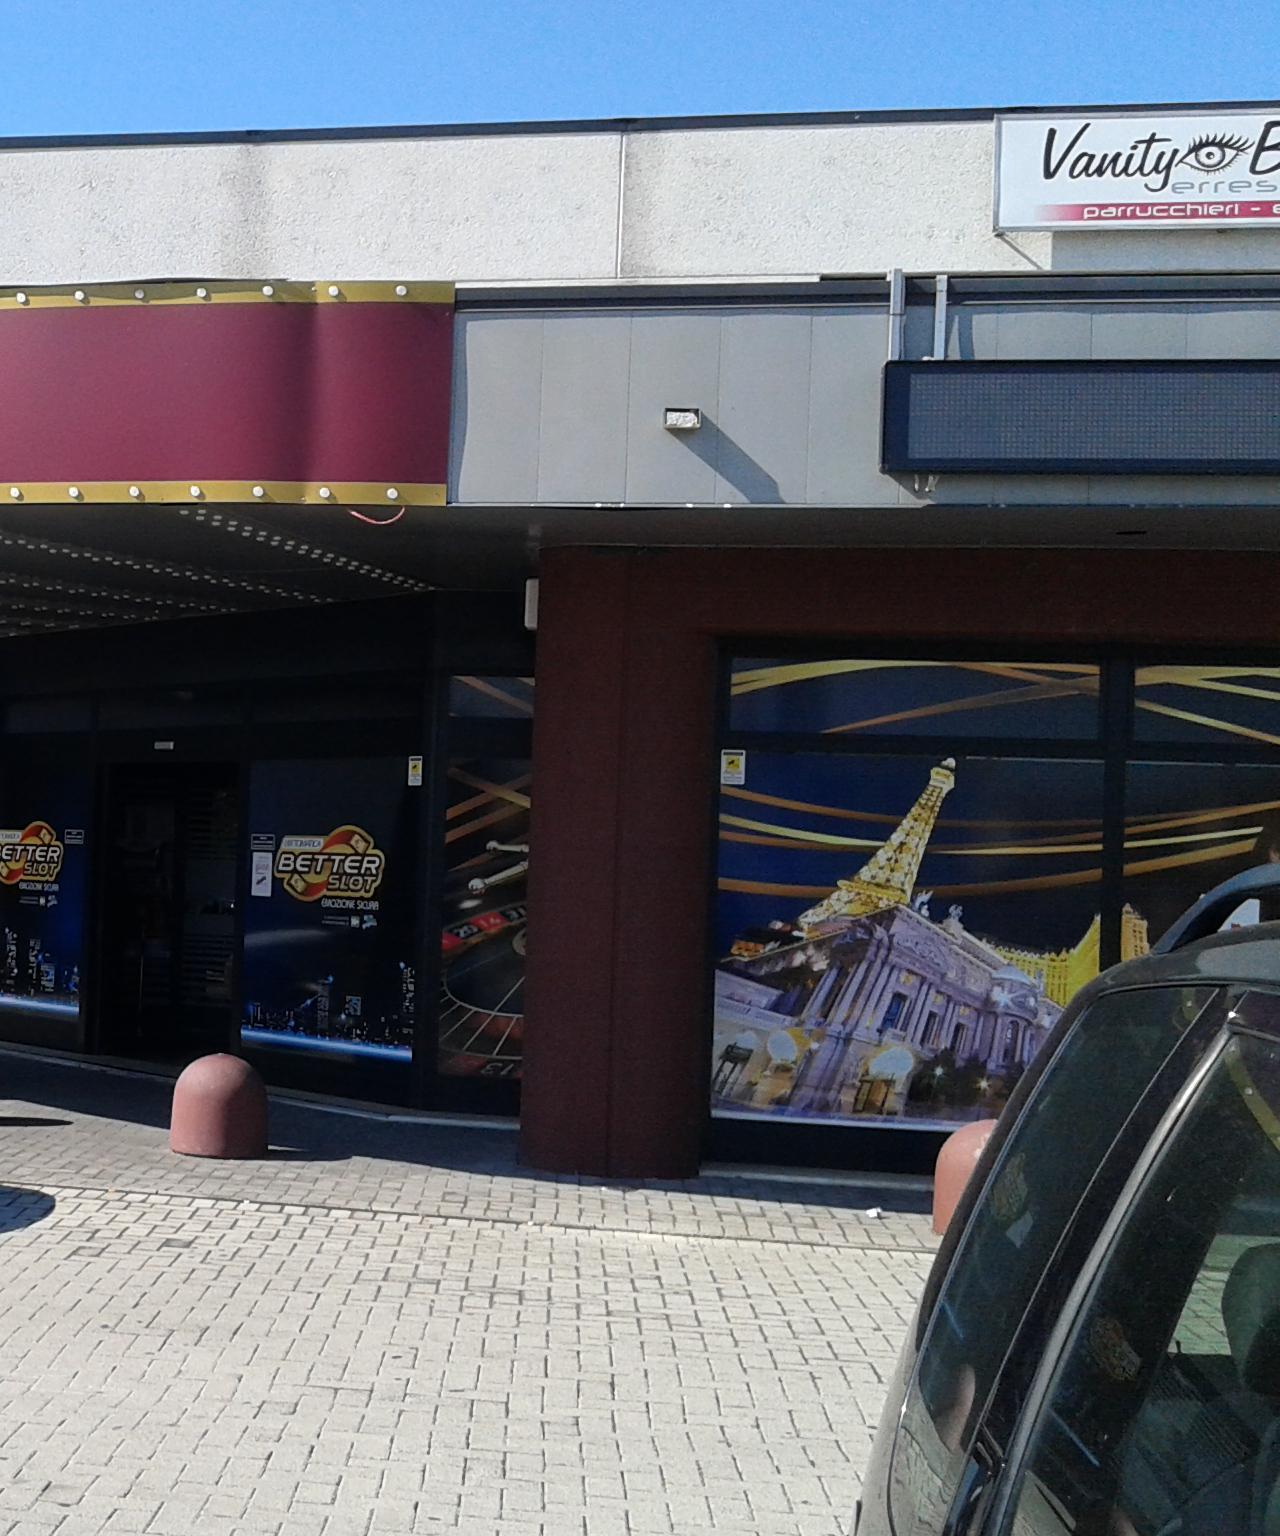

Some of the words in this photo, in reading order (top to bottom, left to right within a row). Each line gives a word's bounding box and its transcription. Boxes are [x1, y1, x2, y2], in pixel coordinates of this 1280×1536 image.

[1042, 122, 1181, 193] Vanity
[1082, 203, 1239, 219] parrucchieri
[24, 862, 58, 877] SLOT
[277, 854, 380, 875] BETTER
[327, 875, 378, 892] SLOT
